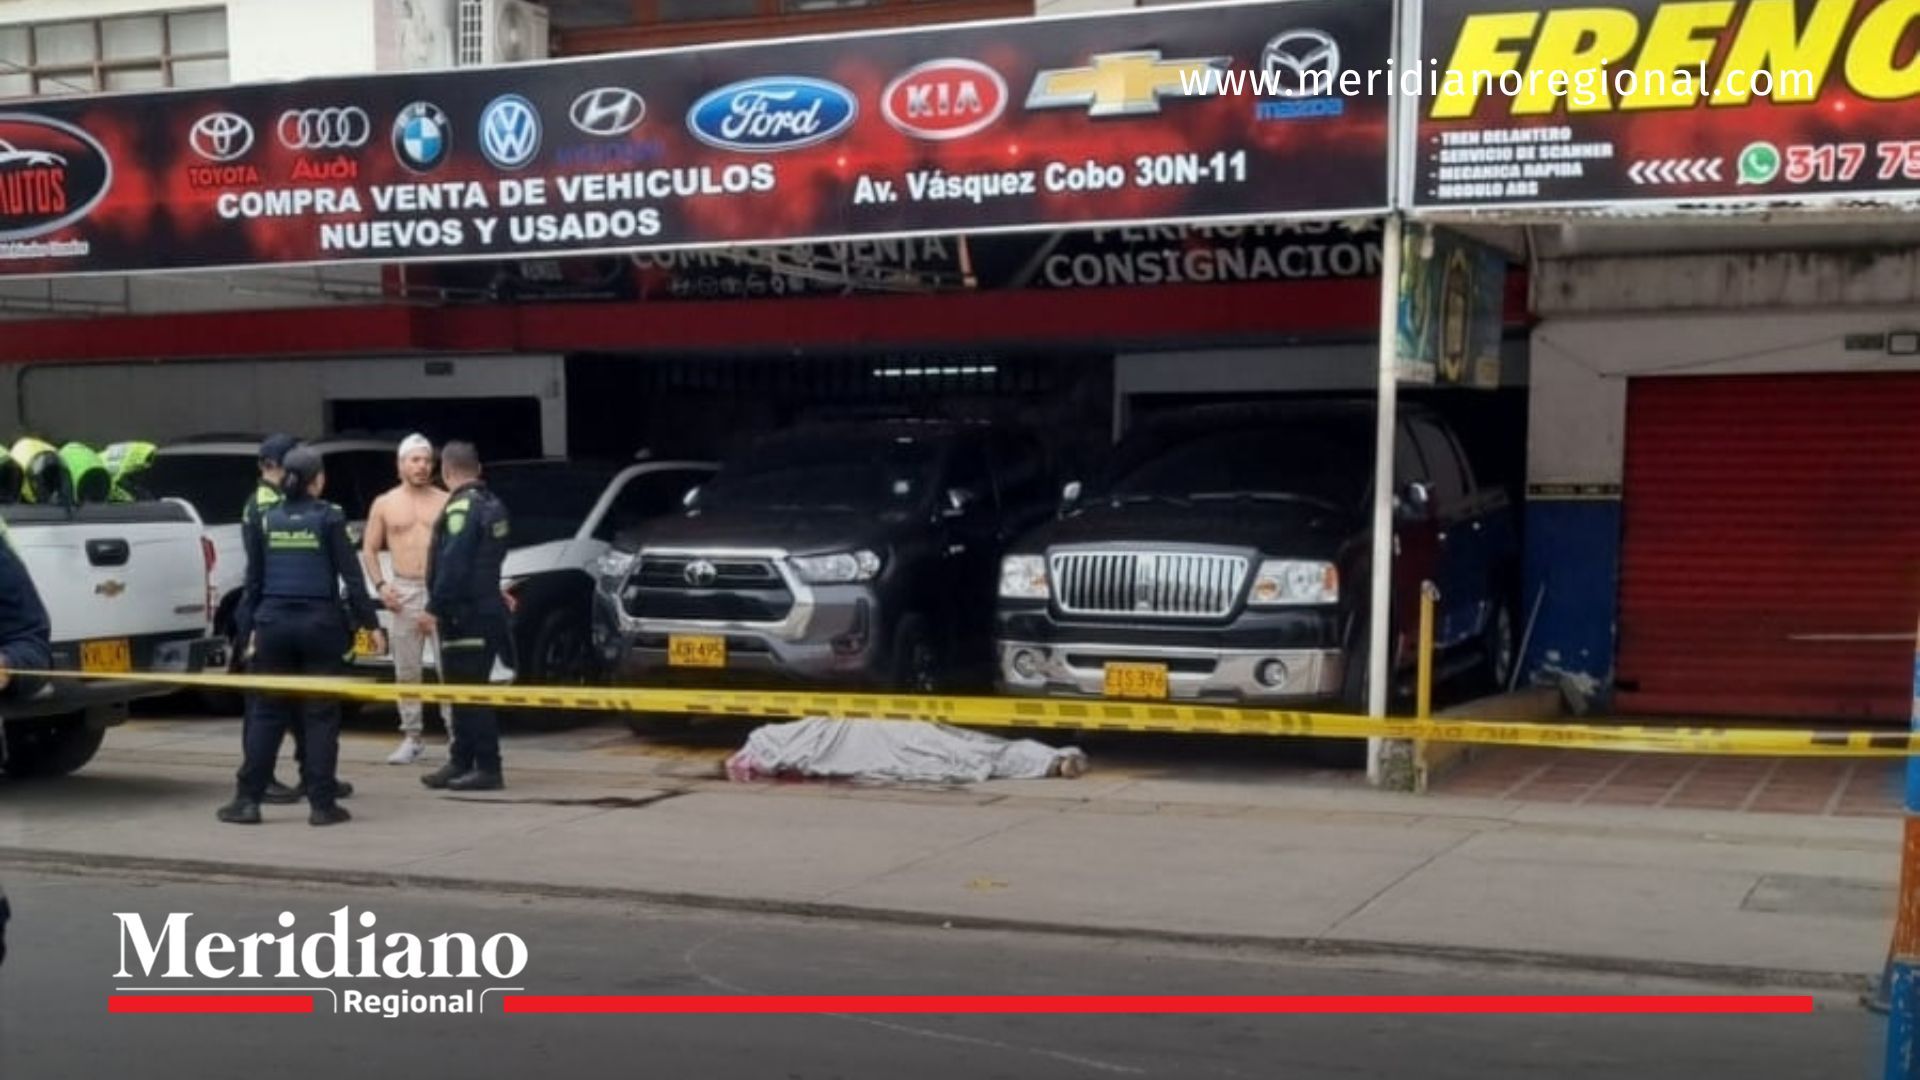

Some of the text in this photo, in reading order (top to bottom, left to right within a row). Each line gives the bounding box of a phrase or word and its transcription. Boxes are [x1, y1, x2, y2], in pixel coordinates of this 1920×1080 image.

[722, 86, 822, 141] Ford
[906, 82, 983, 117] KIA
[189, 167, 259, 187] TOYOTA
[291, 157, 359, 180] Audi
[854, 150, 1248, 204] Av. Vásquez Cobo 30N-11
[1785, 142, 1866, 184] 317
[217, 163, 775, 219] COMPRA VENTA DE VEHICULOS
[320, 207, 660, 250] NUEVOS Y USADOS
